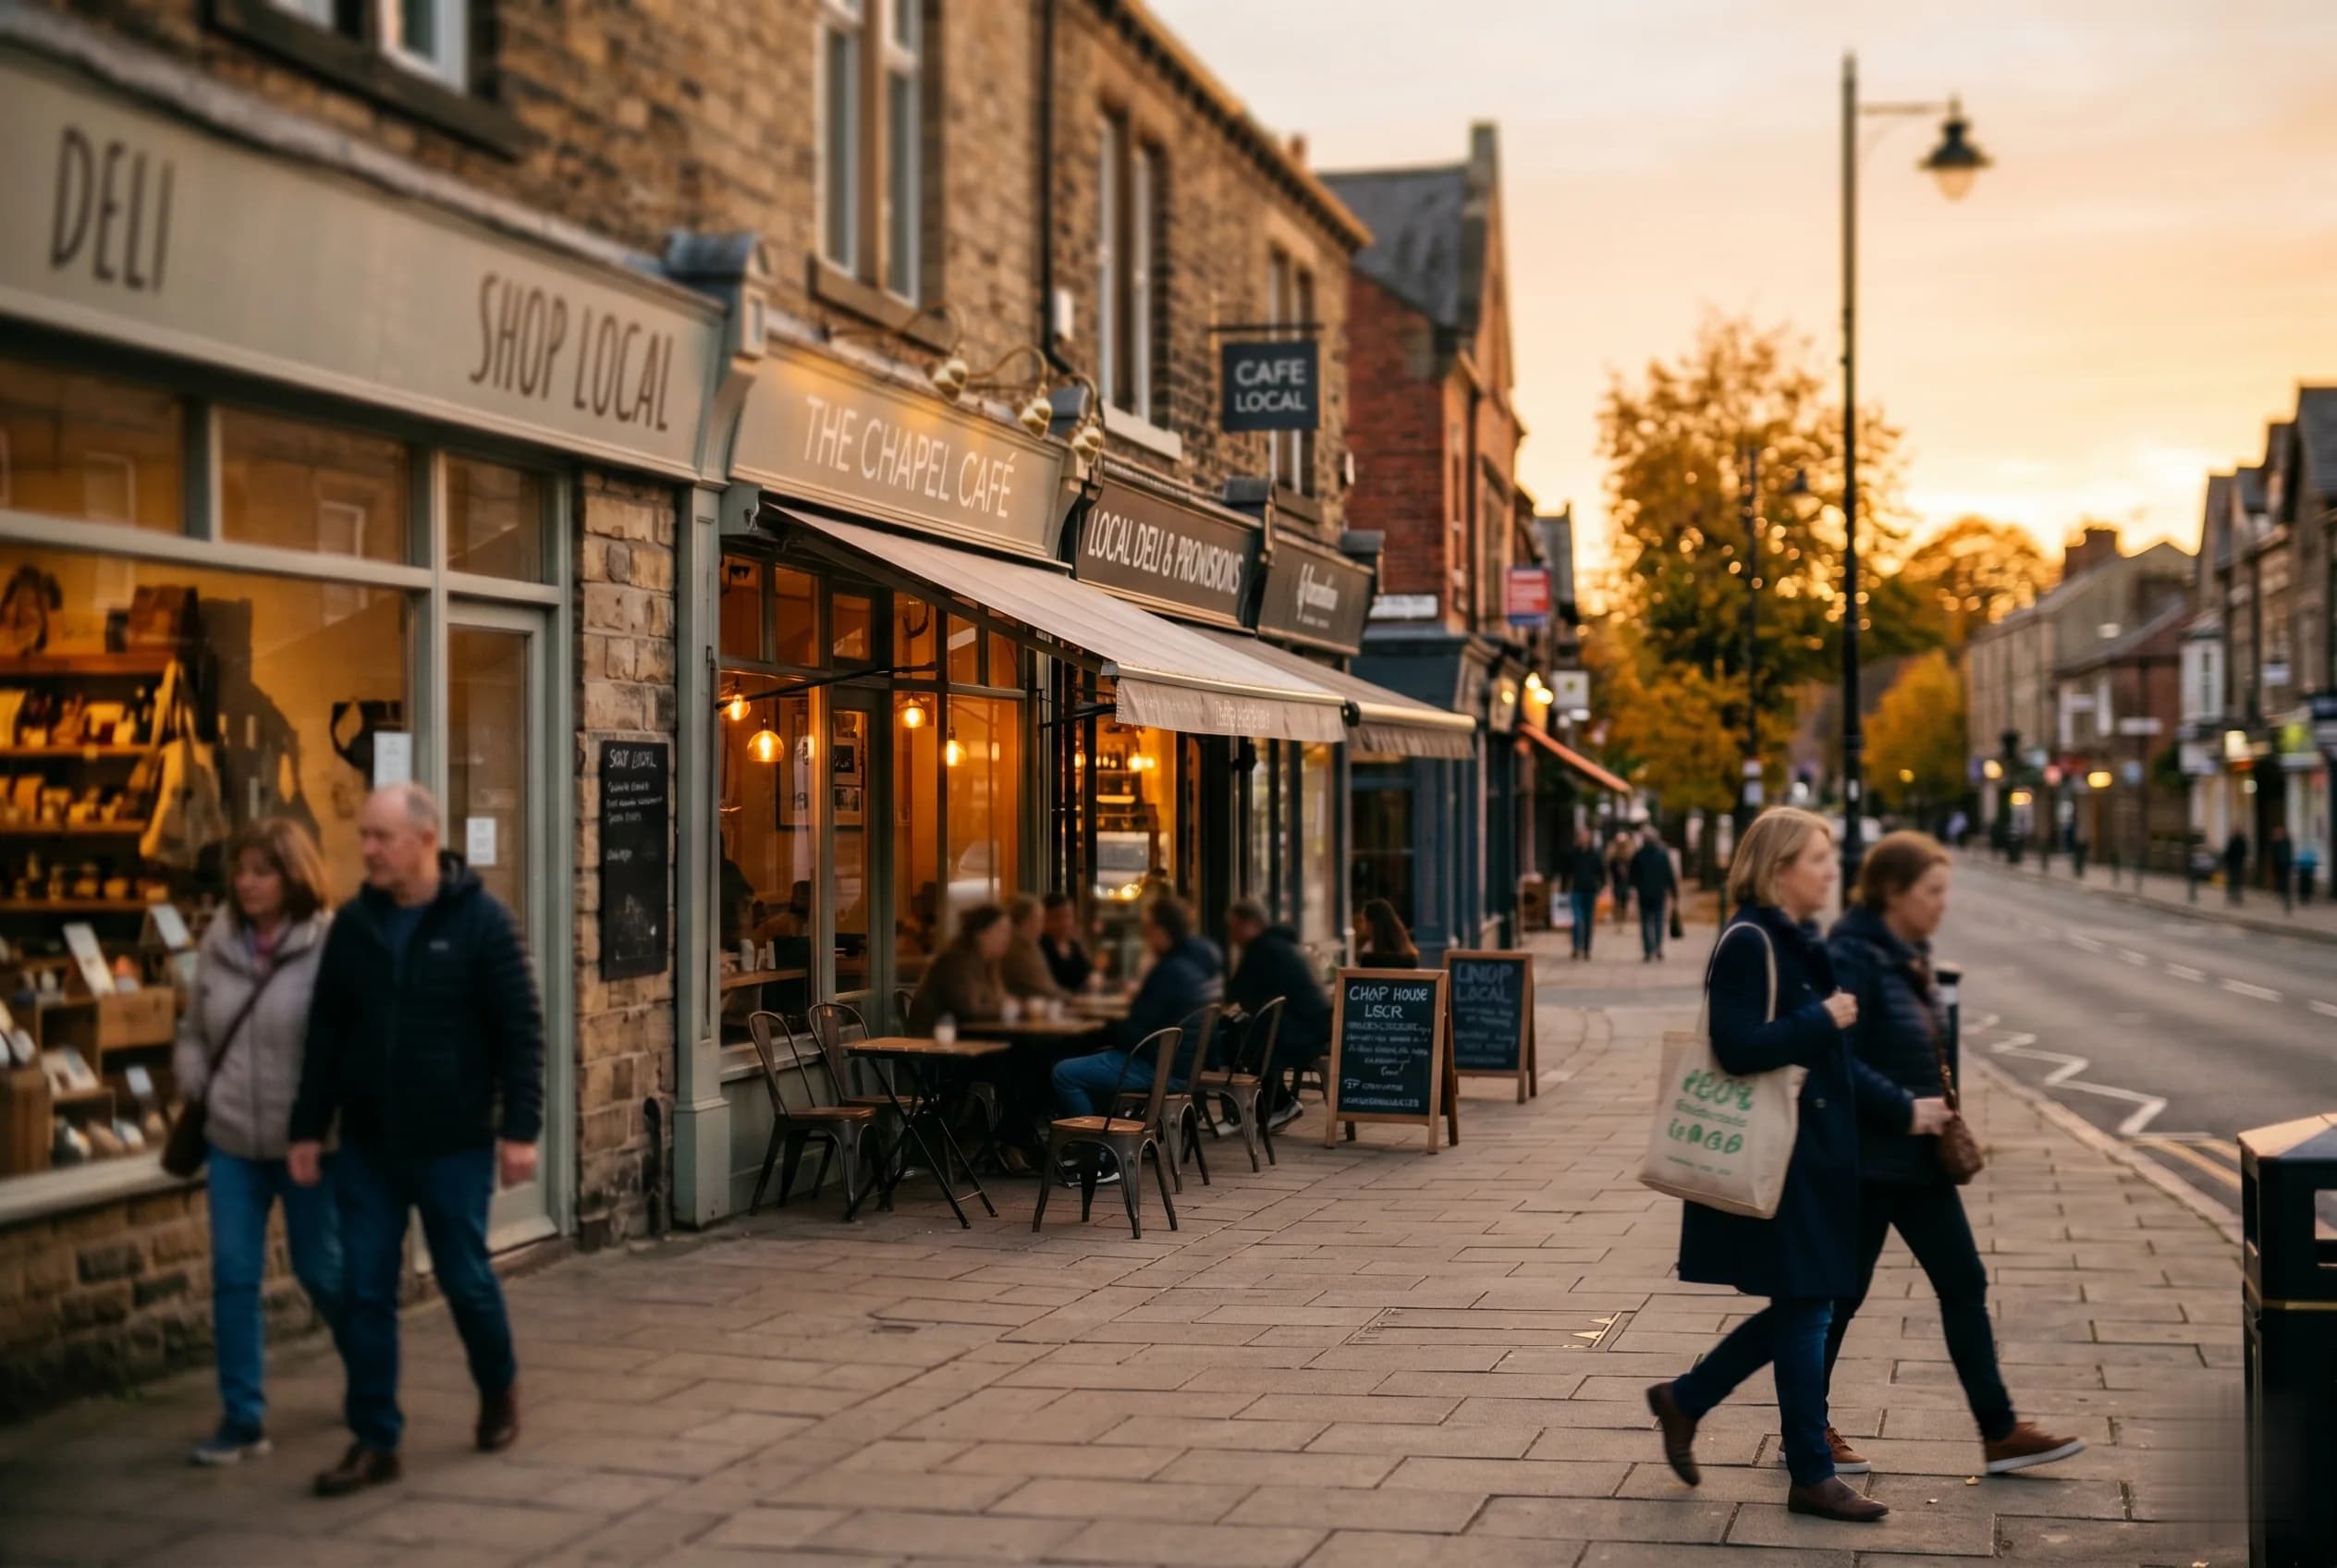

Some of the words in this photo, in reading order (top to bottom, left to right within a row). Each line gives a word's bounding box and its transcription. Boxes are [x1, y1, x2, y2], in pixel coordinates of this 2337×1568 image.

[51, 124, 176, 296] DELI
[470, 271, 569, 401] SHOP
[573, 307, 674, 432] LOCAL
[1235, 359, 1306, 386] CAFE
[1235, 390, 1307, 412] LOCAL
[804, 395, 858, 472] THE
[861, 418, 950, 502] CHAPEL
[958, 451, 1017, 519] CAFÉ
[1088, 508, 1133, 566] LOCAL
[1350, 986, 1389, 1001] CHAP
